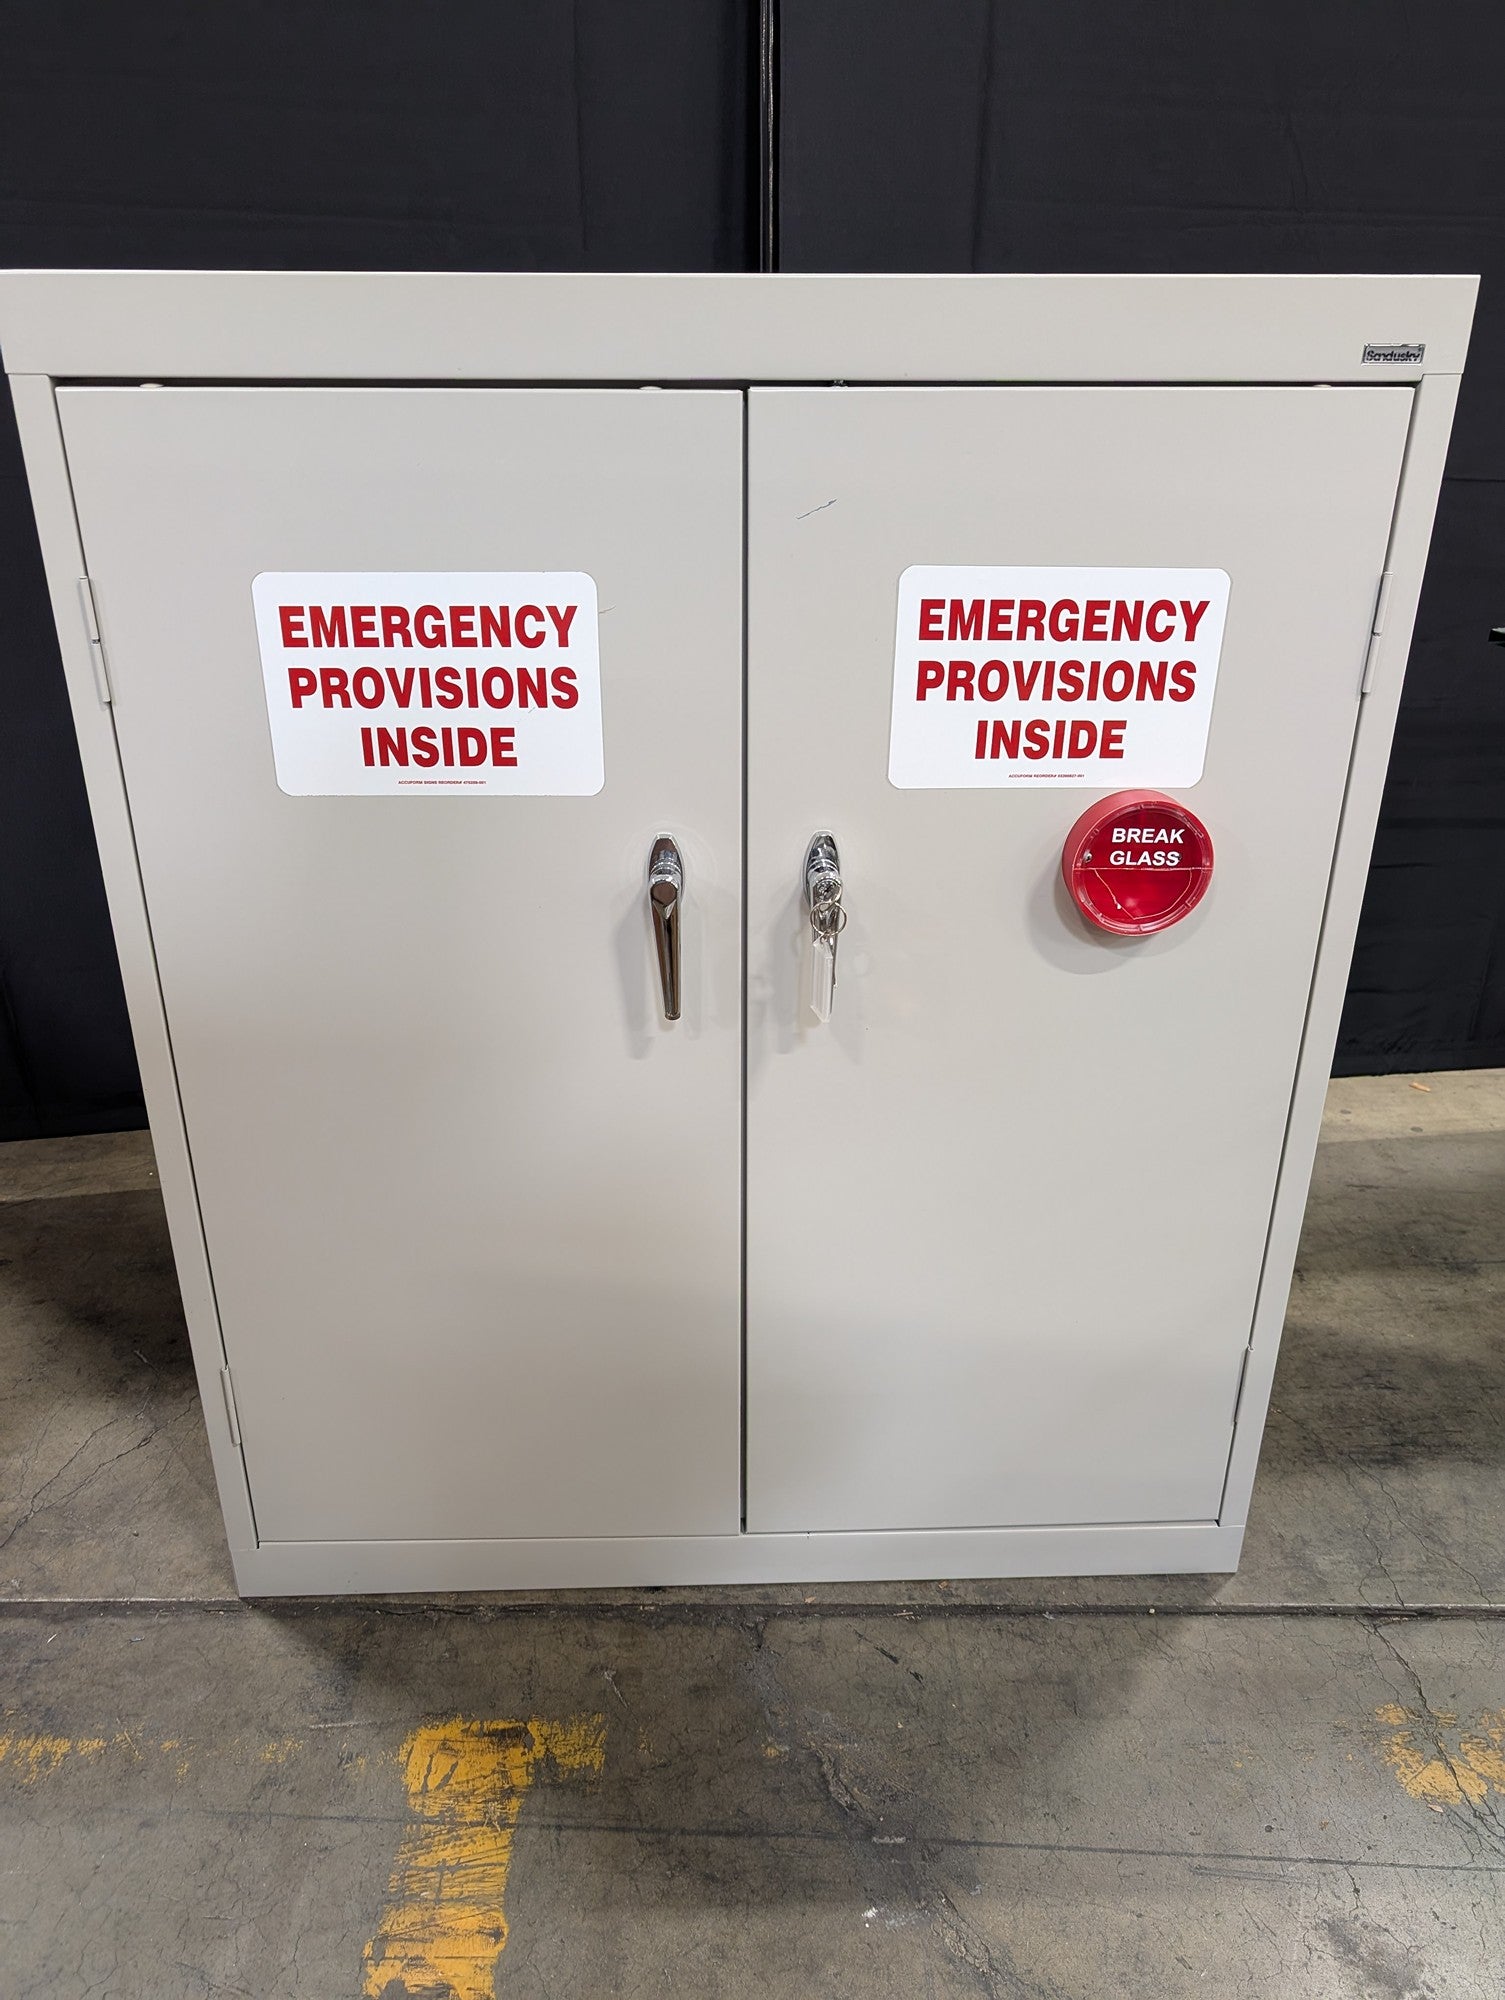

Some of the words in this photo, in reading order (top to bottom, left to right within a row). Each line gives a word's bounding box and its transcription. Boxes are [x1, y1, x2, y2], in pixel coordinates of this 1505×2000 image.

[1366, 349, 1421, 362] Sandusky
[278, 605, 577, 648] EMERGENCY
[918, 599, 1209, 642] EMERGENCY
[288, 667, 579, 709] PROVISIONS
[916, 659, 1197, 702] PROVISIONS
[361, 726, 518, 767] INSIDE
[975, 719, 1127, 759] INSIDE
[1112, 828, 1185, 844] BREAK
[1109, 850, 1180, 866] GLASS
